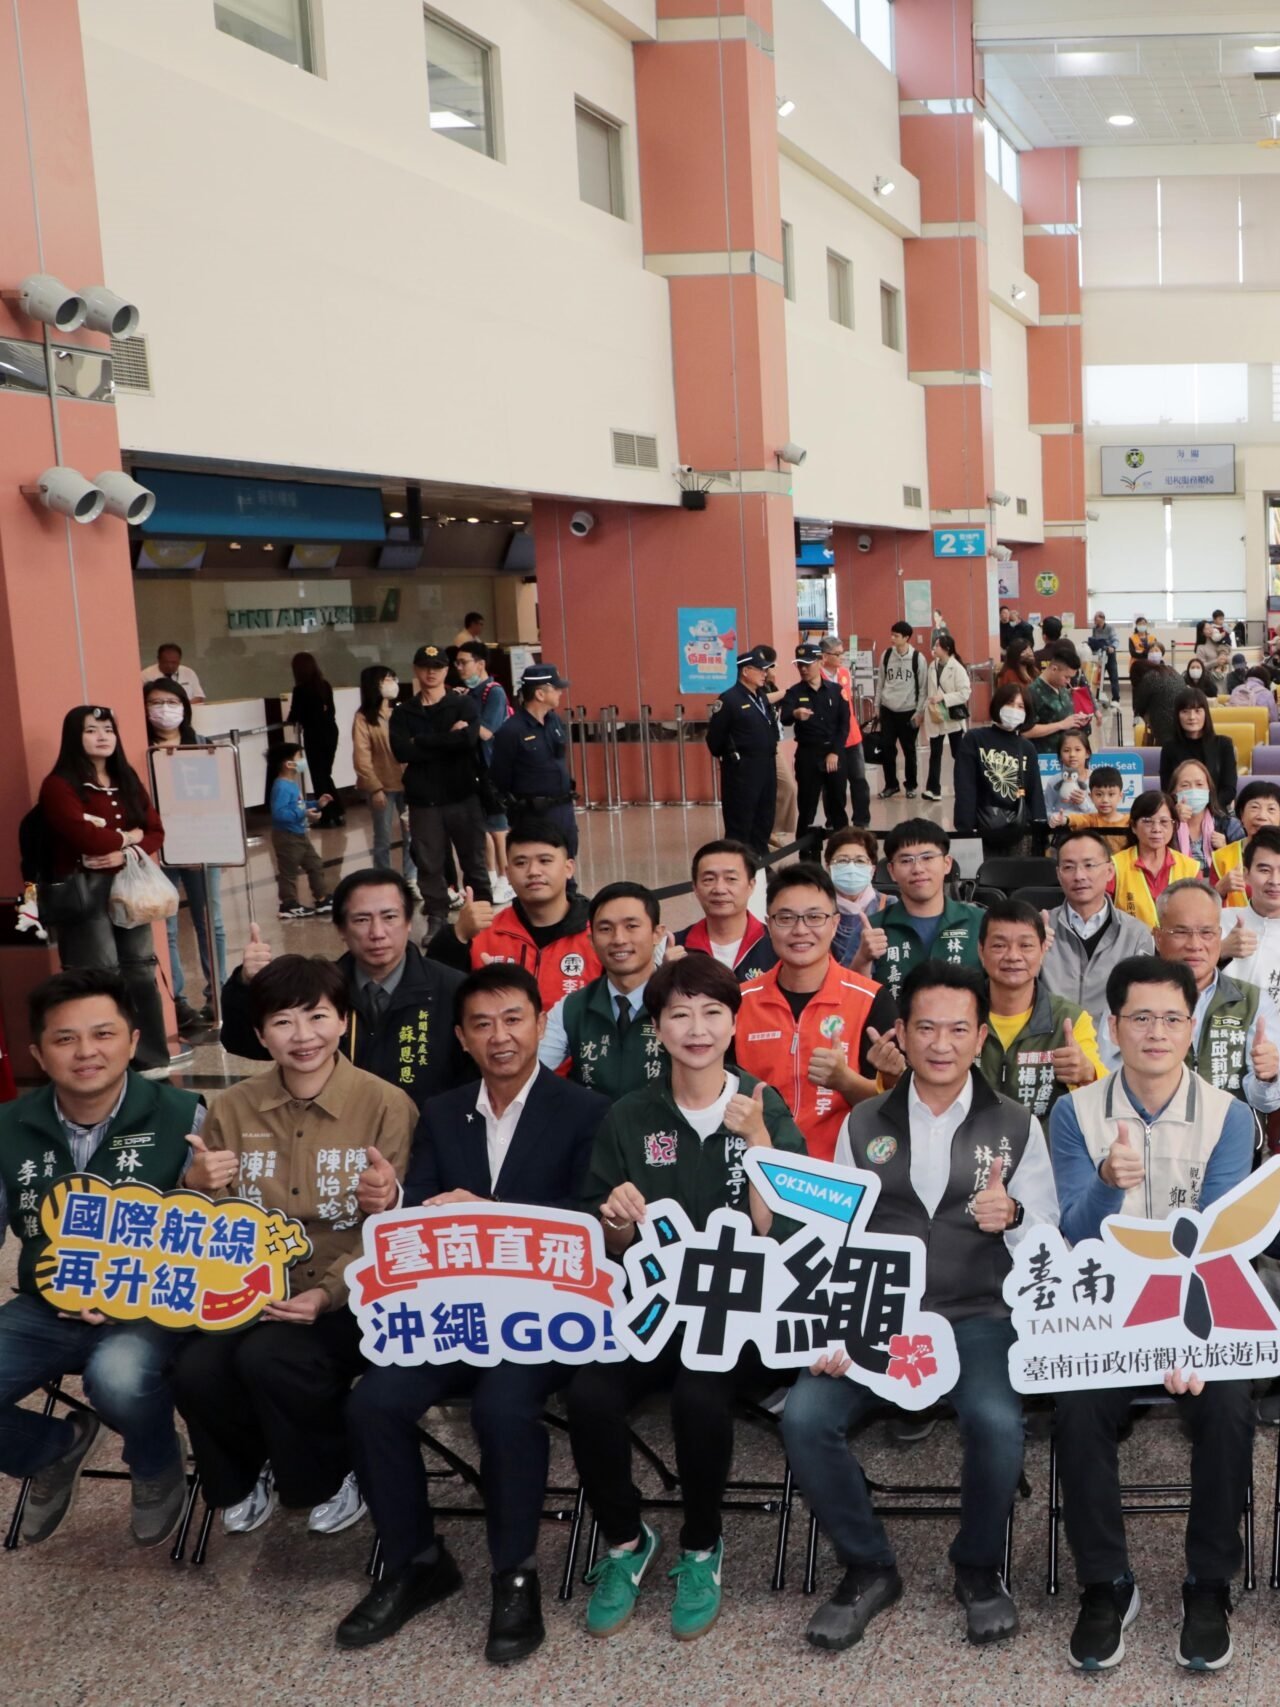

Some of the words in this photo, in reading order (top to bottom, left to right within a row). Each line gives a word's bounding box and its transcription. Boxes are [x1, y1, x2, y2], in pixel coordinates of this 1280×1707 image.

[940, 533, 957, 553] 2
[887, 667, 913, 681] GAP
[1116, 761, 1137, 771] Seat
[113, 1149, 143, 1184] 林
[316, 1148, 343, 1220] 陳怡珍
[774, 1173, 854, 1208] OKINAWA
[61, 1193, 257, 1266] 國際航線
[379, 1223, 586, 1281] 臺南直飛
[53, 1248, 200, 1313] 再升級
[628, 1225, 910, 1375] 沖繩
[1018, 1243, 1116, 1311] 臺南
[372, 1302, 490, 1355] 沖繩
[501, 1309, 617, 1353] GO!
[1028, 1314, 1113, 1336] TAINAN
[1023, 1340, 1280, 1382] 臺南市政府觀光旅遊局
